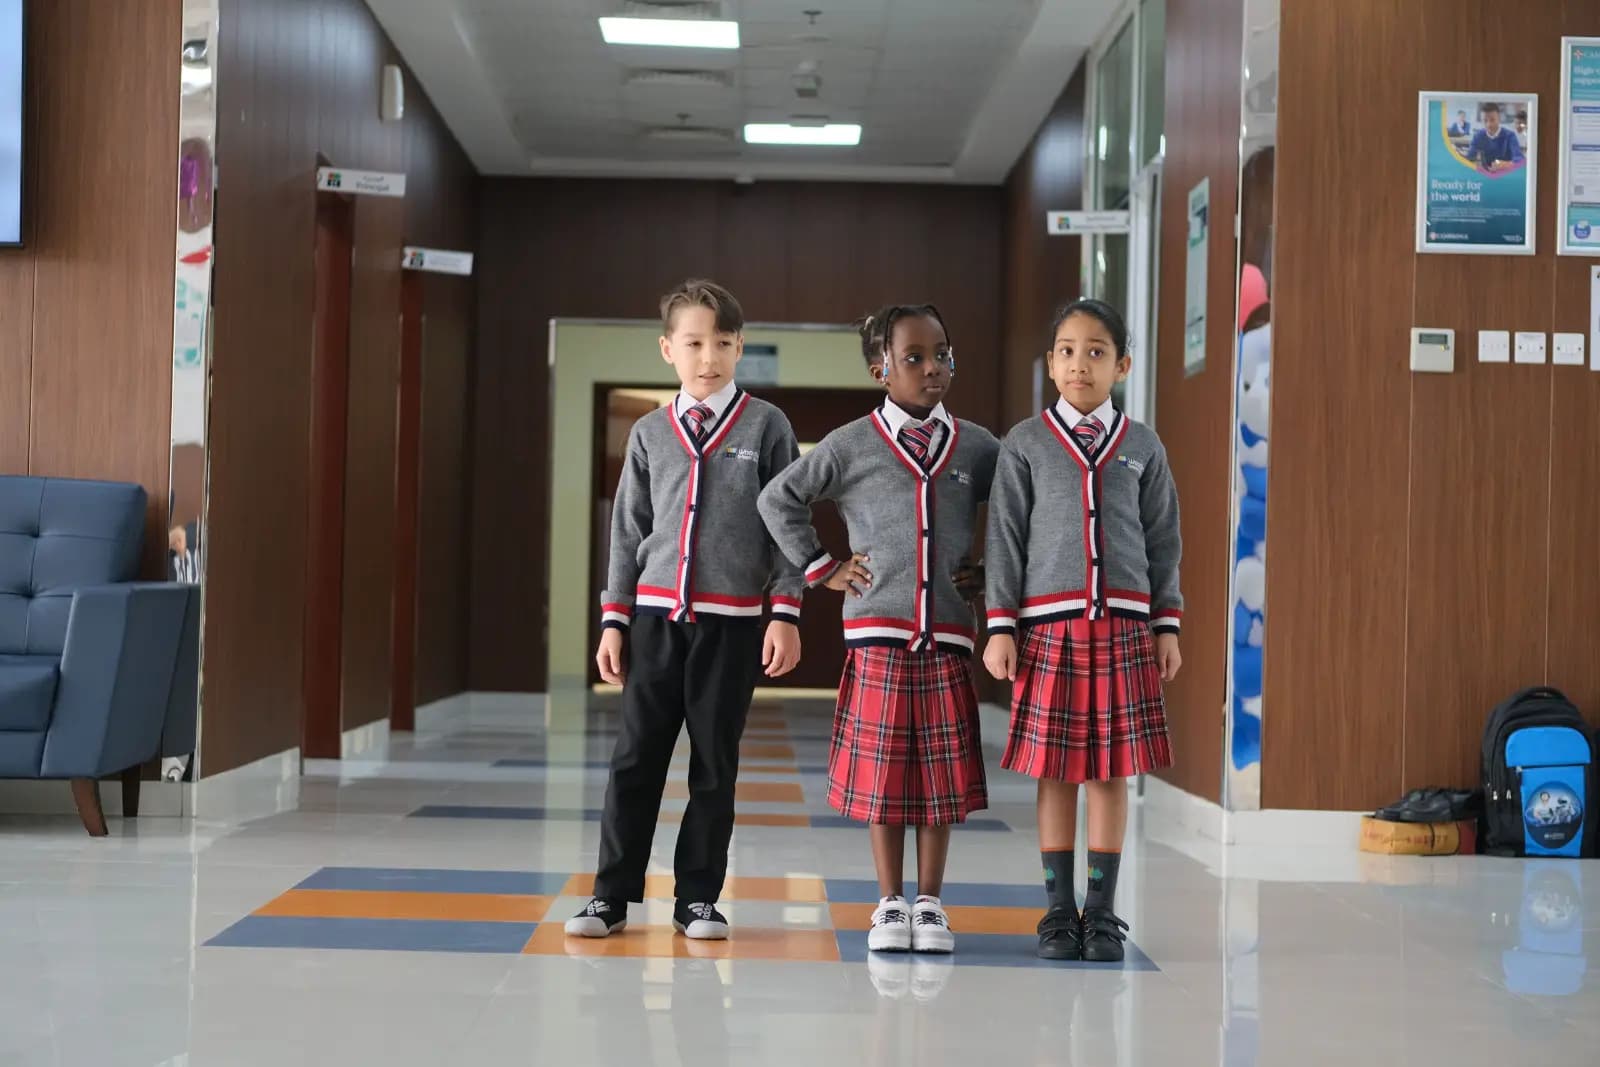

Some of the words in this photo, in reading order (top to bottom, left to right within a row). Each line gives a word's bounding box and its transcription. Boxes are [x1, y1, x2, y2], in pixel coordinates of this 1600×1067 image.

[1431, 180, 1464, 192] Ready
[1466, 180, 1483, 190] for
[1431, 191, 1449, 201] the
[1451, 191, 1480, 202] world
